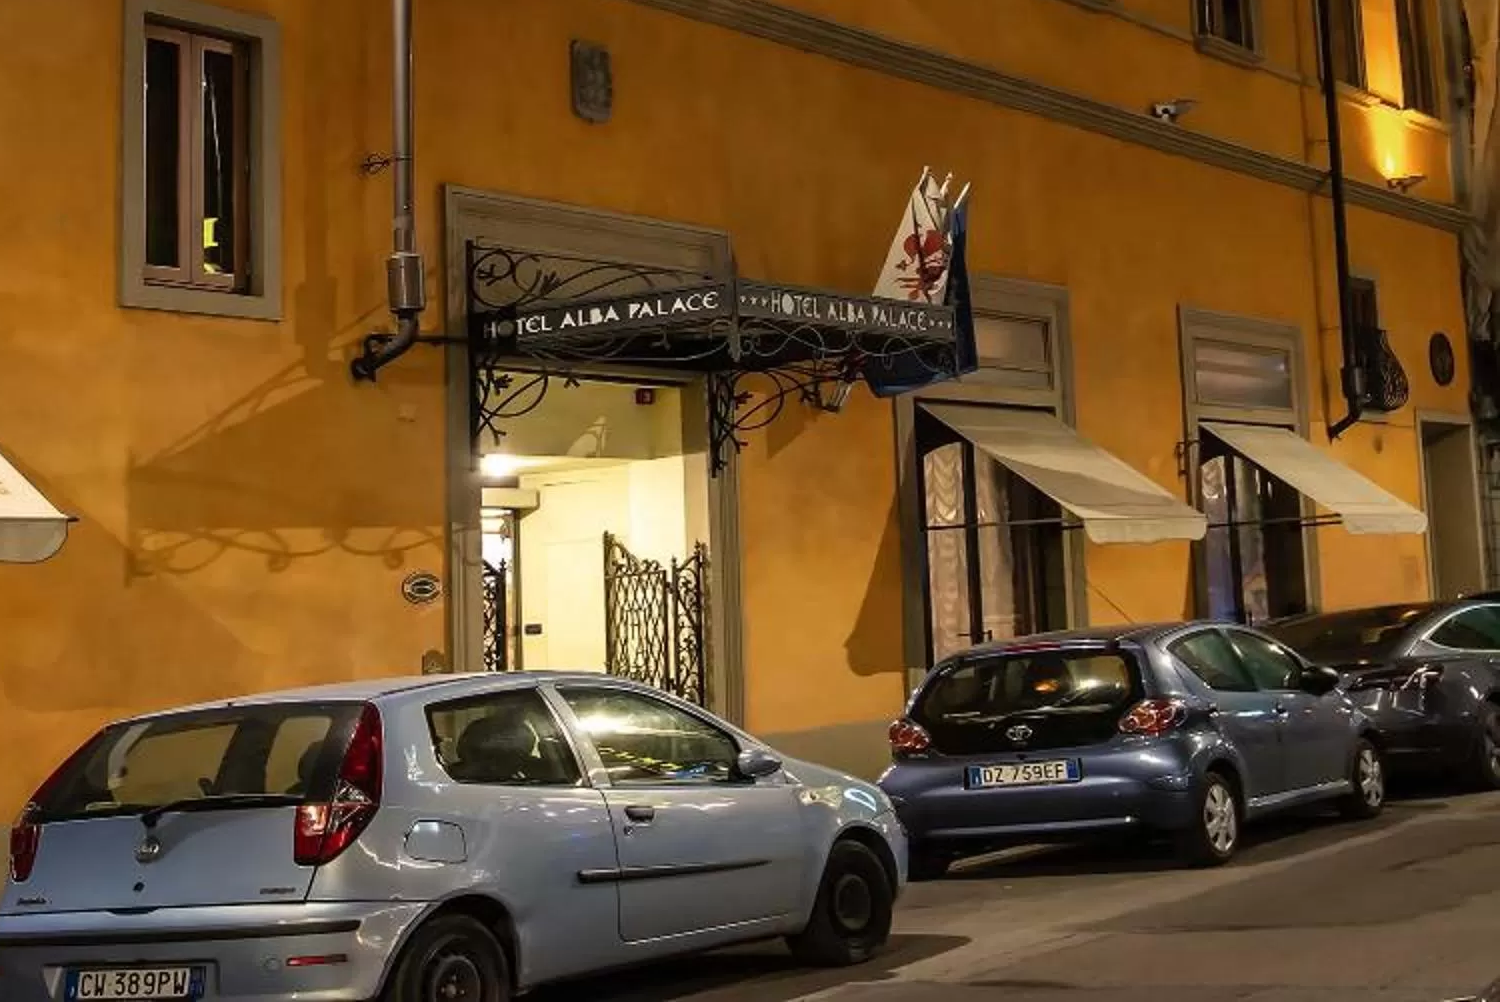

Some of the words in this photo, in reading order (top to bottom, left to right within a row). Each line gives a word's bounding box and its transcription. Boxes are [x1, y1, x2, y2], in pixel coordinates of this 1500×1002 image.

[560, 307, 620, 329] ALBA
[628, 291, 719, 319] PALACE
[770, 291, 821, 319] HOTEL
[827, 302, 867, 325] ALBA
[871, 304, 927, 331] PALACE
[983, 767, 1004, 783] DZ
[1011, 762, 1064, 781] 759EF
[81, 973, 106, 996] CW
[115, 970, 187, 995] 389PW
